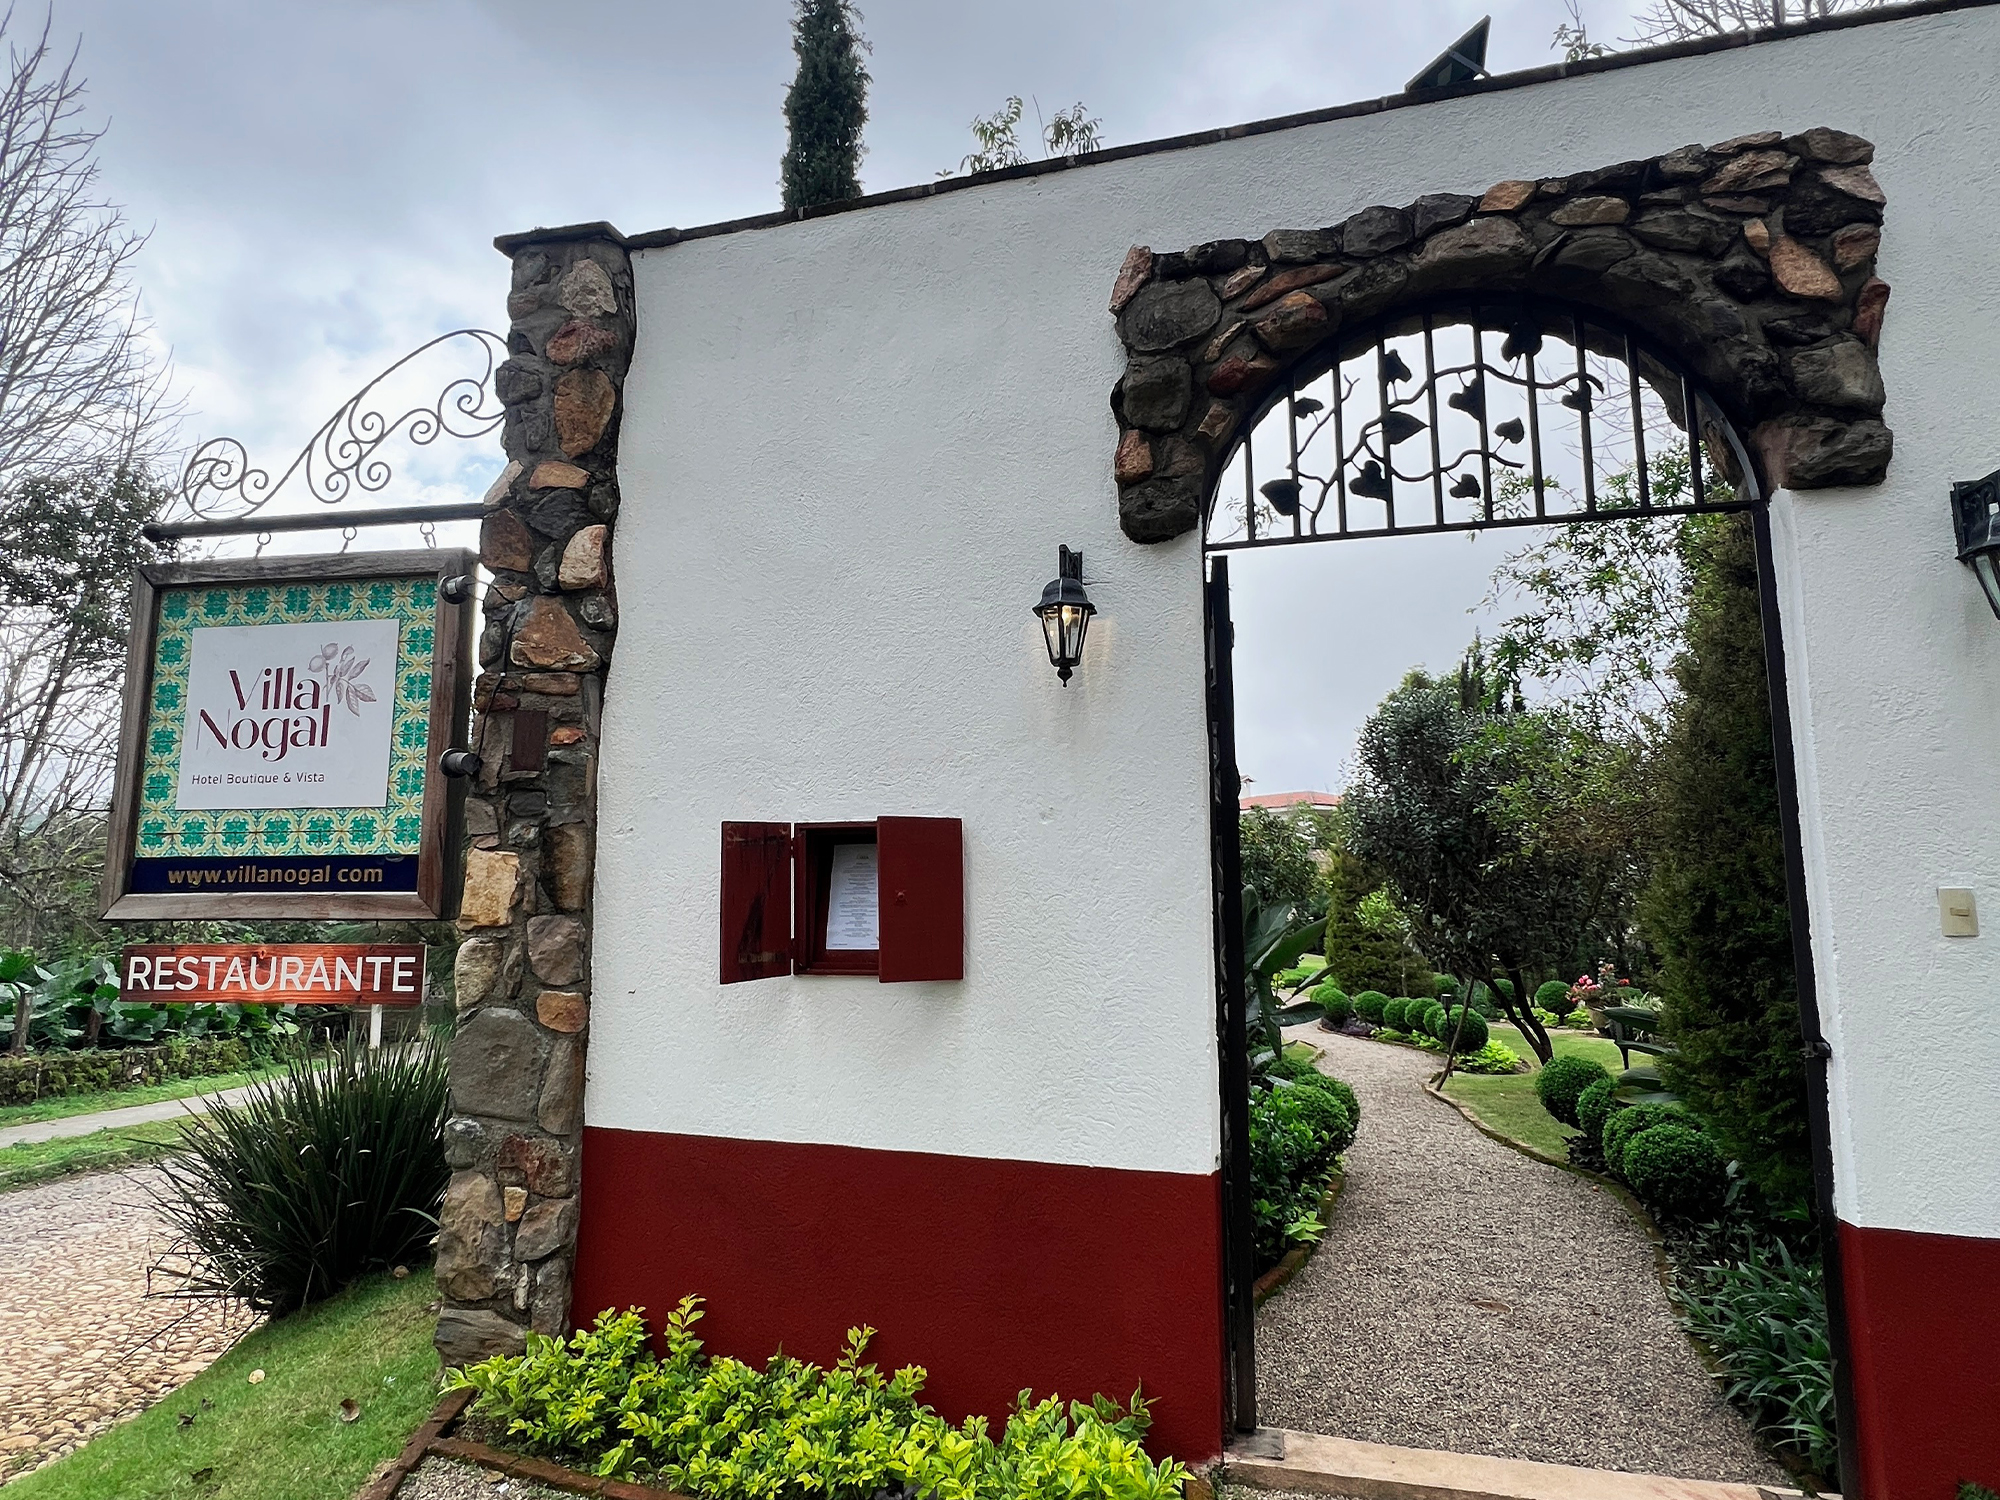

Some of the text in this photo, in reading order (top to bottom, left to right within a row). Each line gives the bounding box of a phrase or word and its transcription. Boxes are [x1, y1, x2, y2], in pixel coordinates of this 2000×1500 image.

[228, 666, 321, 711] Villa
[196, 703, 331, 763] Nogal
[192, 772, 325, 785] Hotel Boutique & Vista
[126, 956, 417, 992] RESTAURANTE
